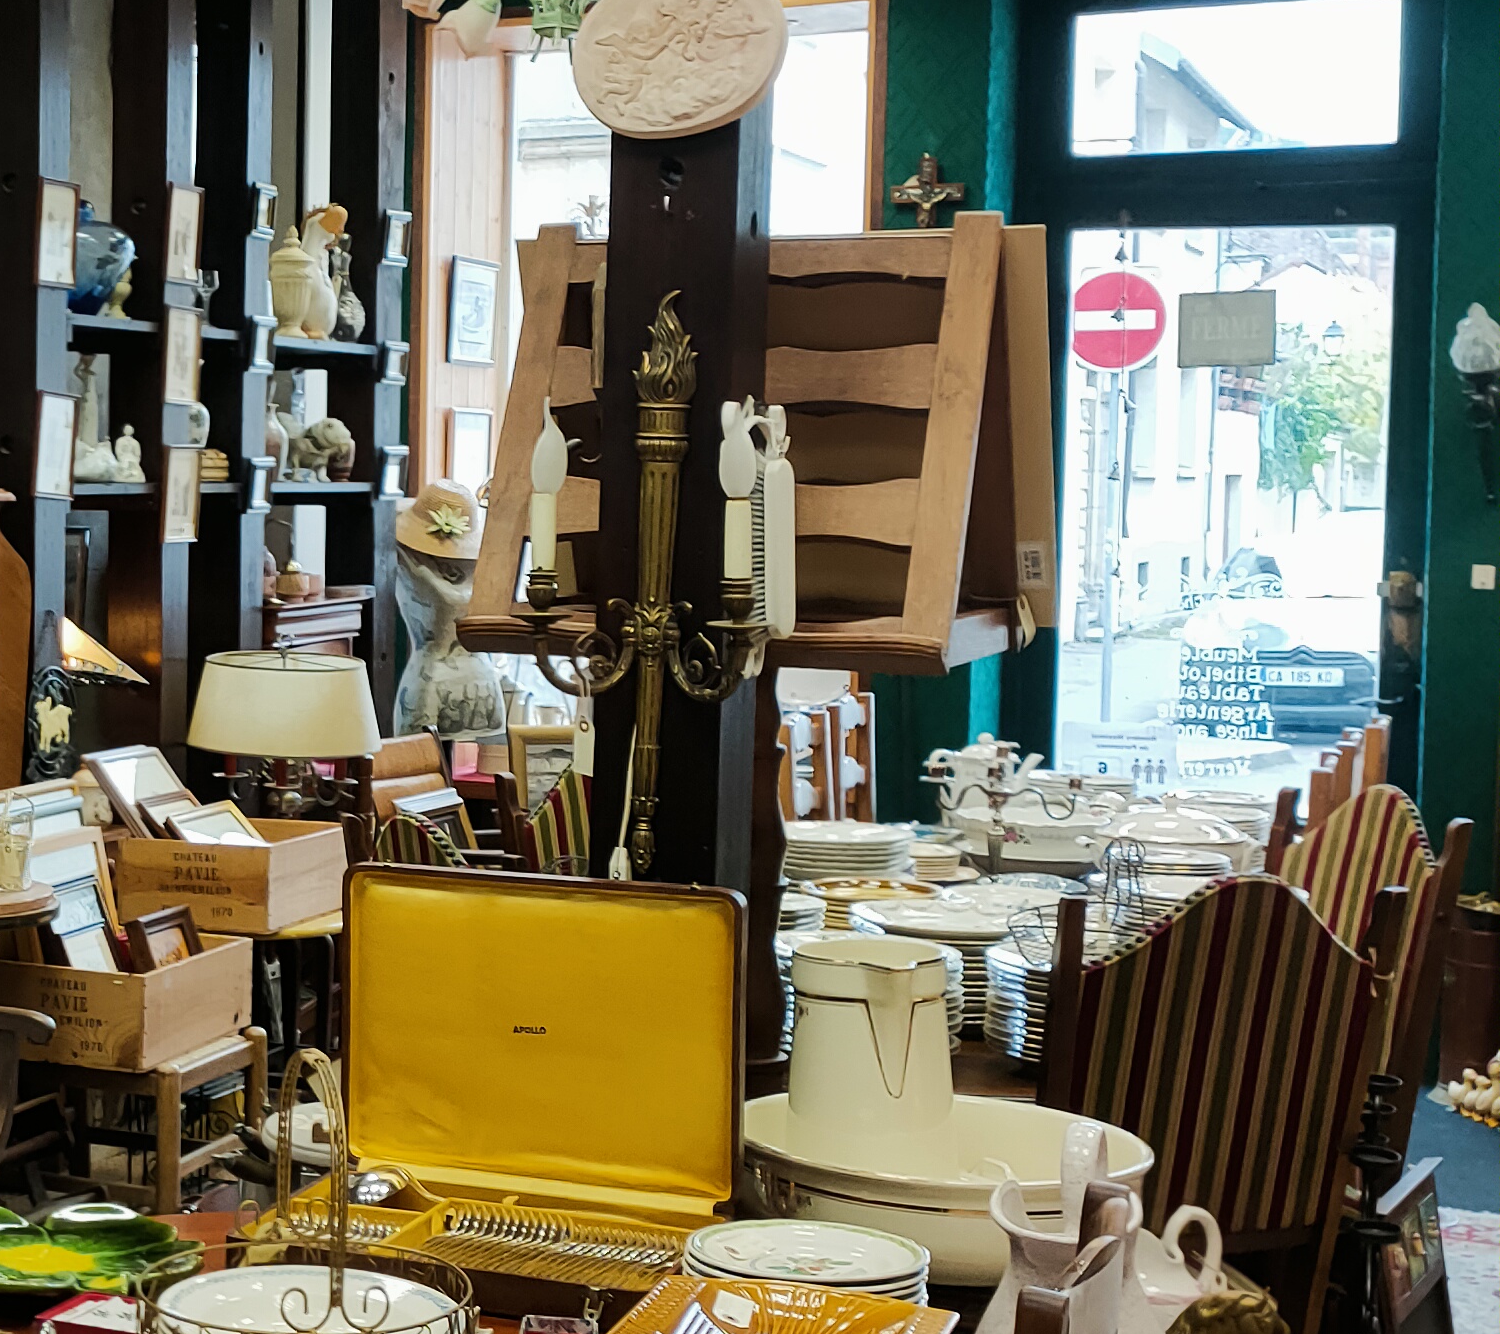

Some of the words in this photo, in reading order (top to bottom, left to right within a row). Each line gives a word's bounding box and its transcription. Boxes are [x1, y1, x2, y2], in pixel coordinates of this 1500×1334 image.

[174, 866, 220, 881] PAVIE
[40, 993, 88, 1013] PAVIE
[513, 1025, 547, 1035] APOLLO
